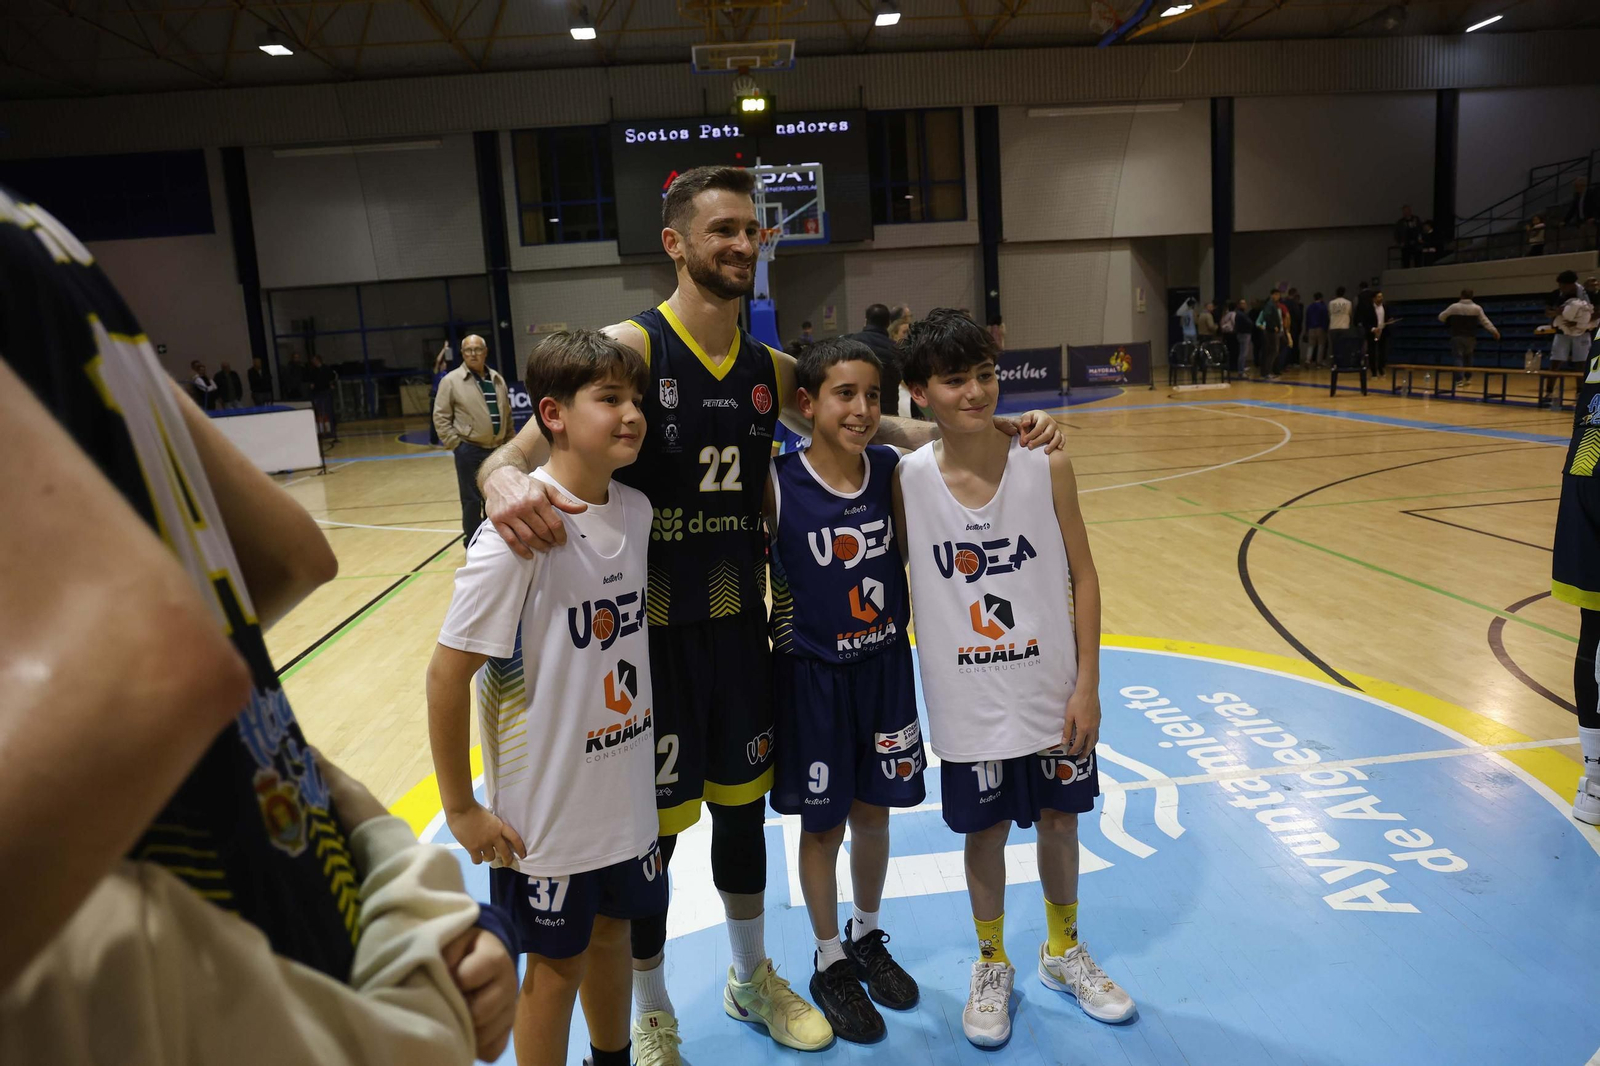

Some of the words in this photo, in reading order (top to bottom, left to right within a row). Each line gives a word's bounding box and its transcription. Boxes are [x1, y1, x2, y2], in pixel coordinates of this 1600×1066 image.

[625, 128, 689, 143] Socios
[699, 120, 849, 140] Patrnadores
[699, 445, 743, 492] 22
[932, 534, 1037, 583] UDEA
[837, 616, 897, 651] KOALA
[957, 638, 1040, 665] KOALA
[958, 658, 1041, 674] CONSTRUCTION
[585, 708, 652, 753] KOALA
[586, 732, 653, 764] CONSTRUCTION
[881, 747, 922, 782] UDE
[1197, 691, 1407, 821] Algeciras
[808, 761, 830, 794] 9
[971, 760, 1004, 793] 10
[1119, 685, 1422, 914] Ayuntamiento
[1384, 828, 1468, 873] de
[527, 875, 570, 912] 37
